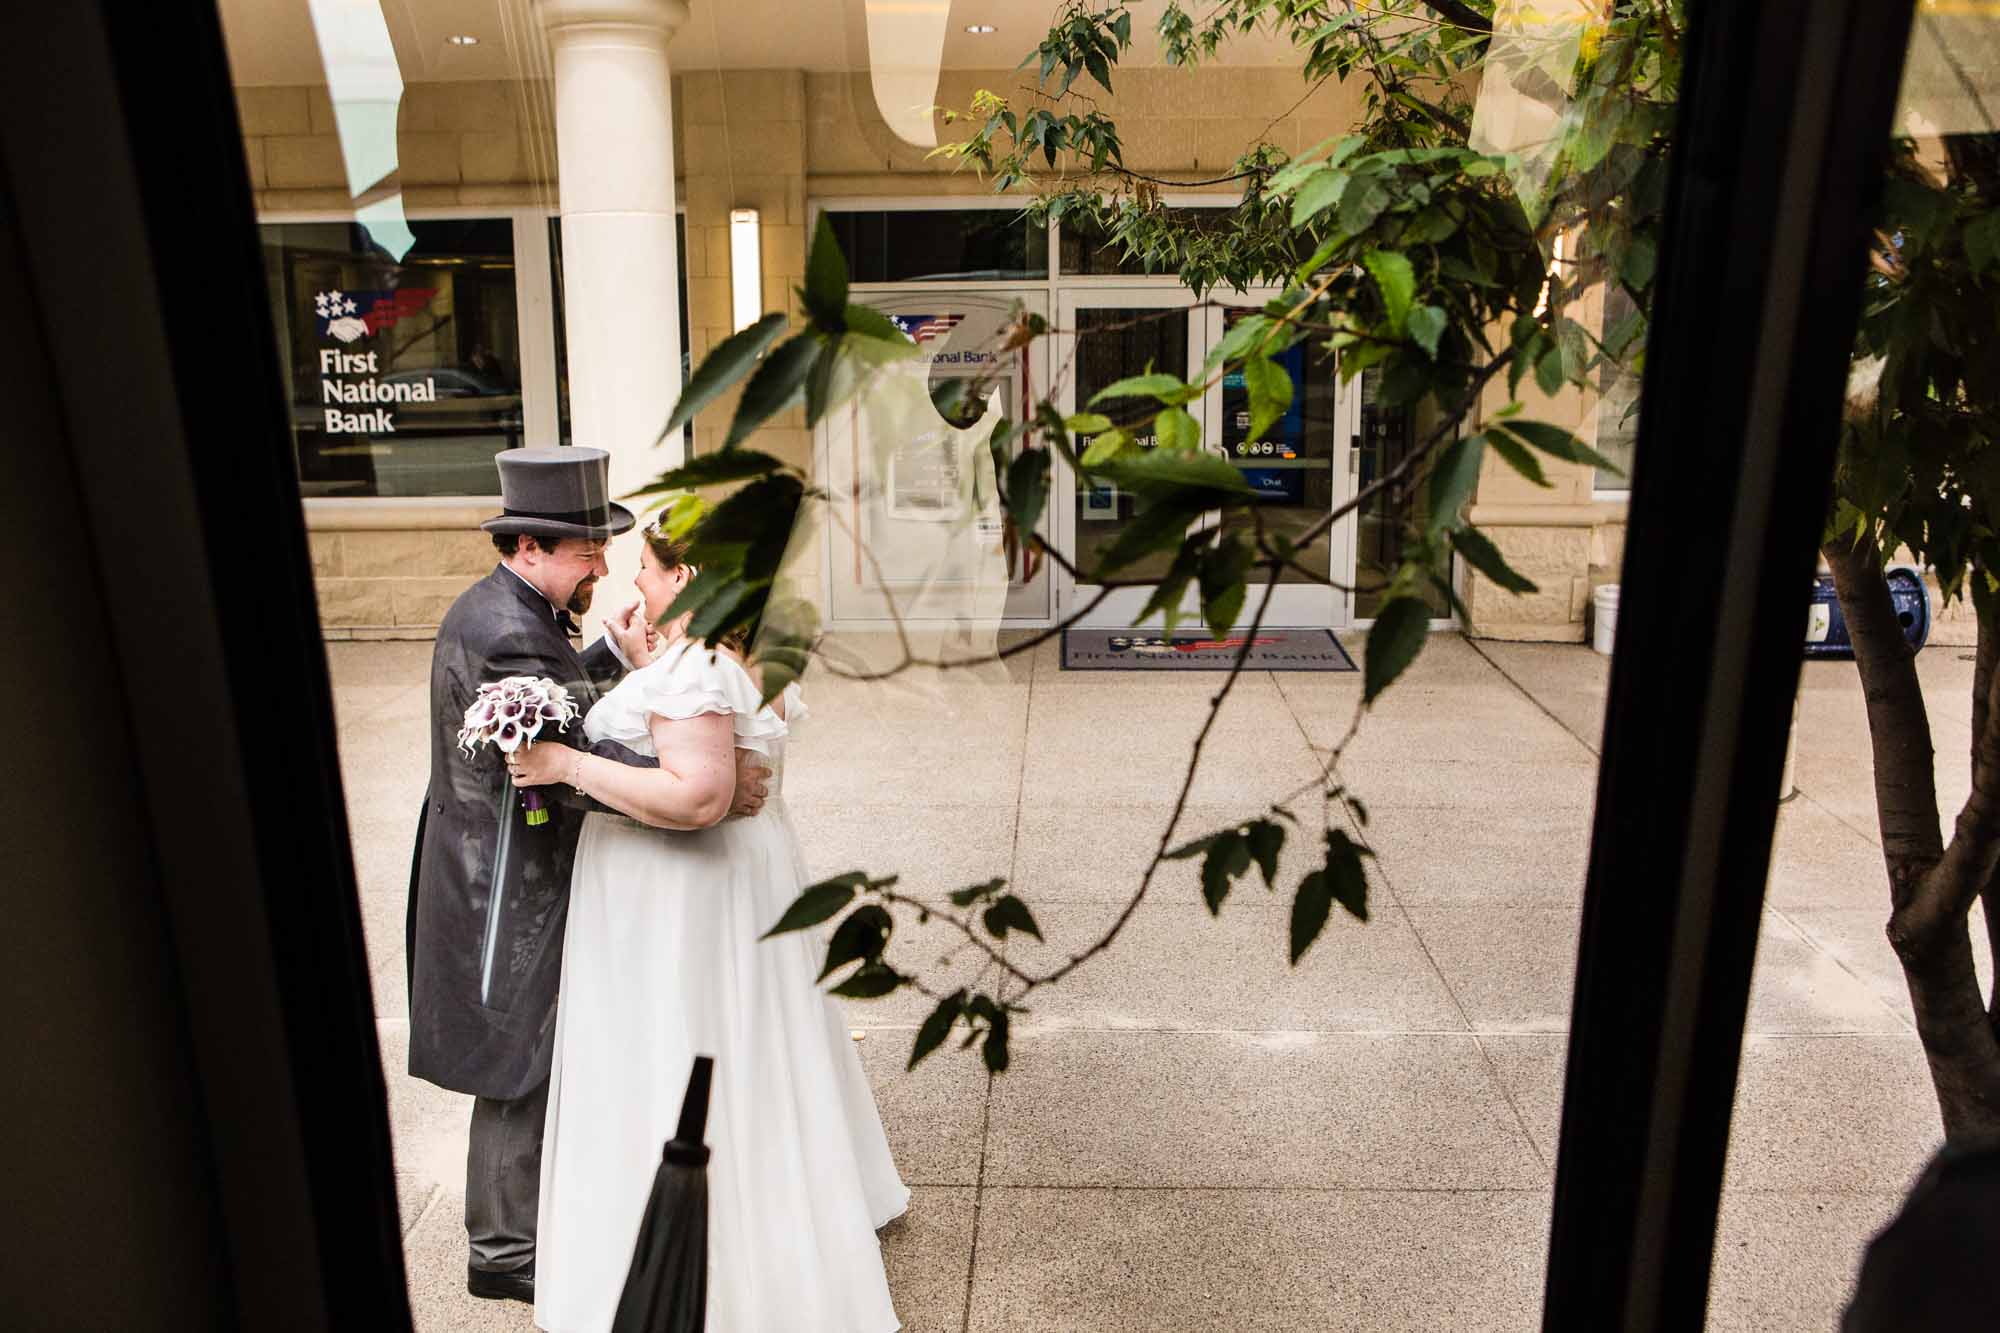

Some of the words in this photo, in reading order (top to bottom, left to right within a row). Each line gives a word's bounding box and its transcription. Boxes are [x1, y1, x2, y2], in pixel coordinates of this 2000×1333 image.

[320, 349, 378, 374] First
[964, 352, 998, 363] Bank
[322, 377, 436, 403] National
[324, 408, 396, 433] Bank
[1073, 652, 1125, 660] First
[1261, 653, 1337, 661] Bank
